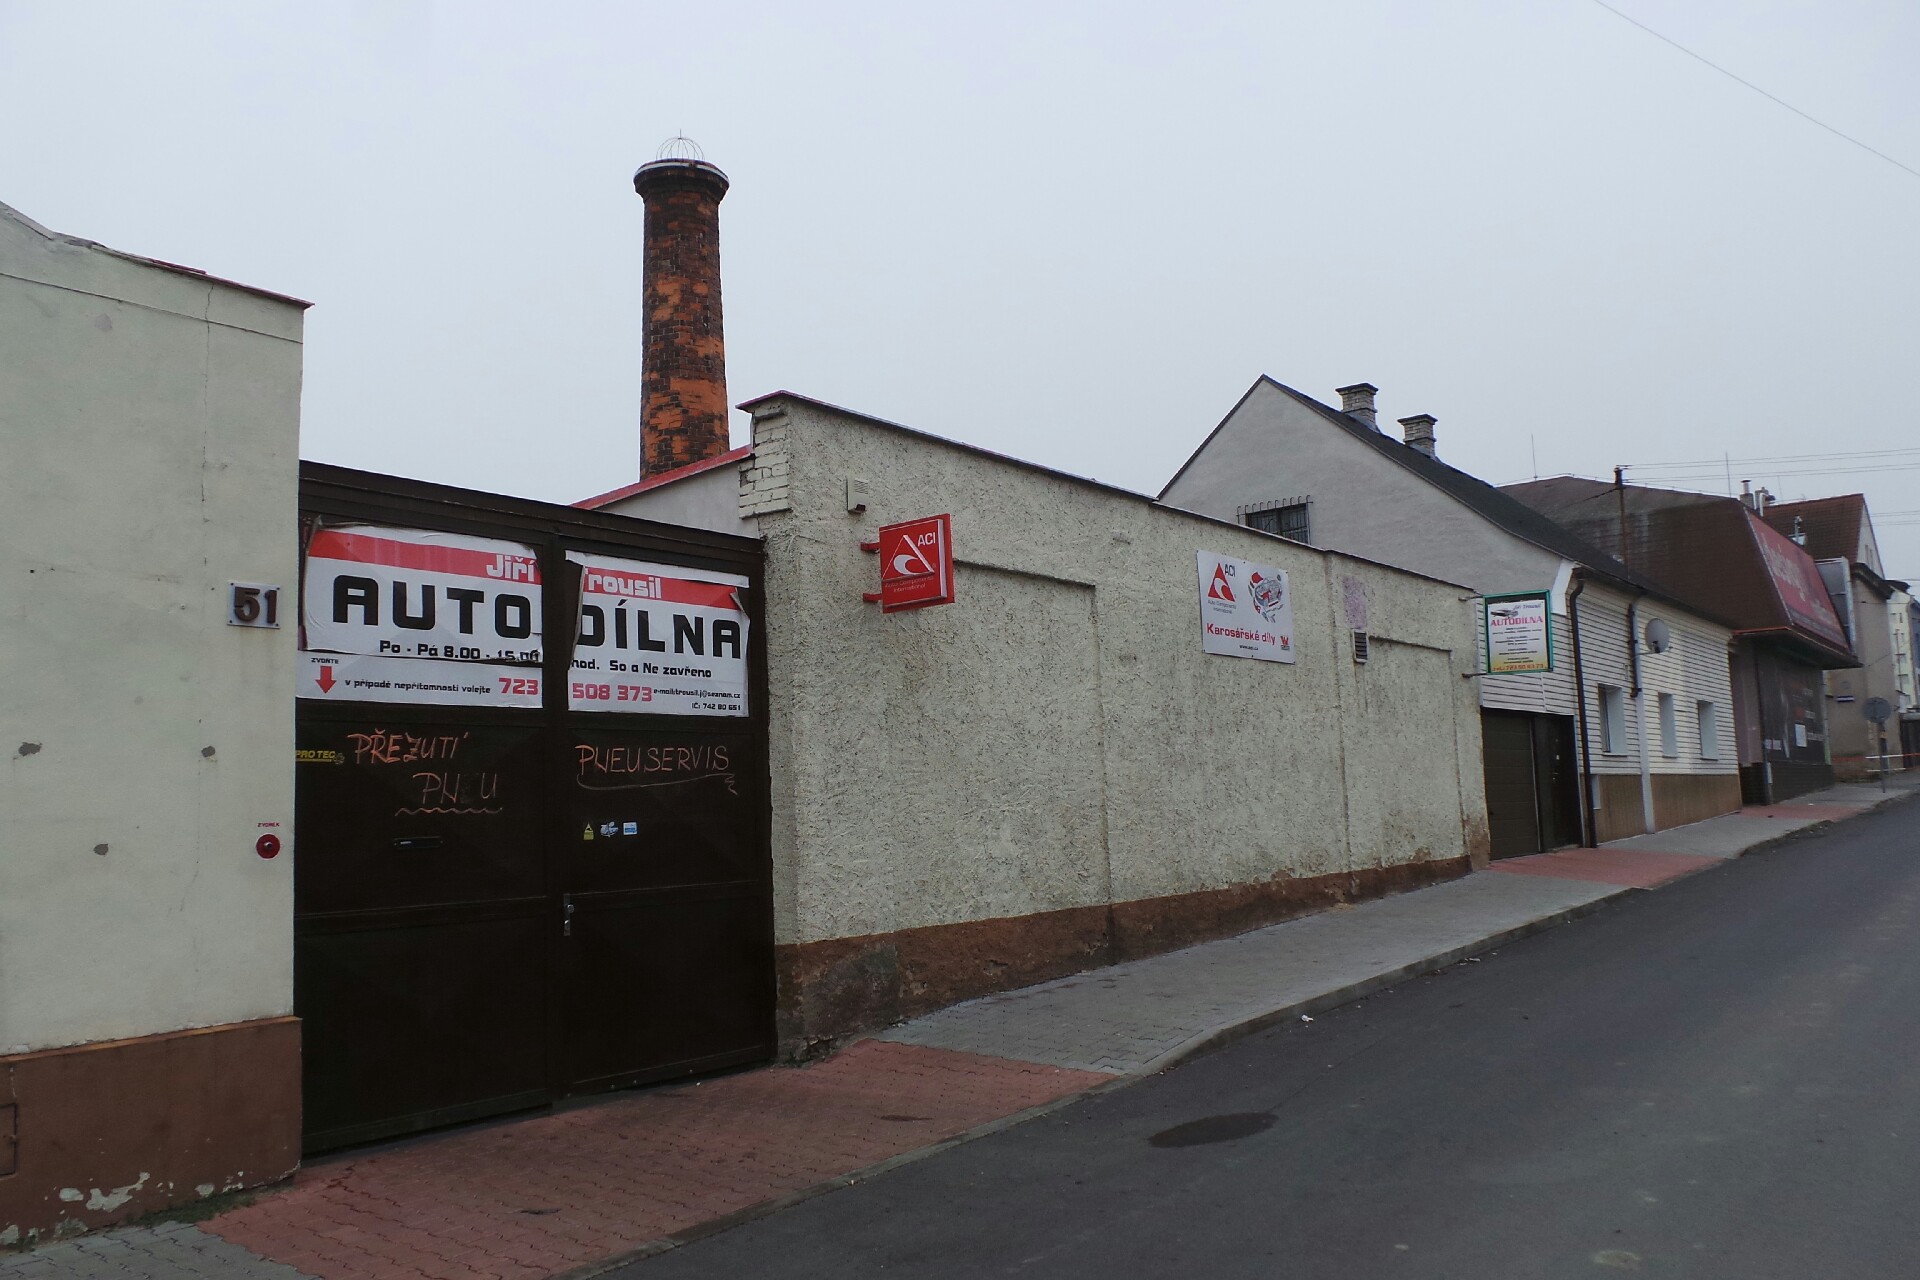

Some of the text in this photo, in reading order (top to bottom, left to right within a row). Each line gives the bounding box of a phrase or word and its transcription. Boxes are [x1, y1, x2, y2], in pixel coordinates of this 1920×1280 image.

[917, 531, 936, 547] ACI
[485, 554, 662, 599] Jiří rousil
[1224, 563, 1236, 577] ACI
[234, 586, 278, 624] 51
[332, 574, 531, 640] AUTO
[576, 599, 741, 660] DÍLNA
[1491, 615, 1543, 627] AUTODÍLNA
[1206, 623, 1276, 645] Karosářské díly
[379, 640, 401, 654] Po
[417, 643, 438, 657] Pá
[443, 646, 481, 660] 8.00
[609, 660, 627, 672] So
[631, 663, 639, 672] a
[643, 662, 659, 675] Ne
[663, 666, 712, 678] zavřeno
[354, 678, 391, 689] případě
[461, 684, 491, 694] volejte
[498, 677, 539, 695] 723
[572, 682, 610, 700] 508
[617, 685, 652, 702] 373
[574, 744, 729, 776] PNEUSERVIS
